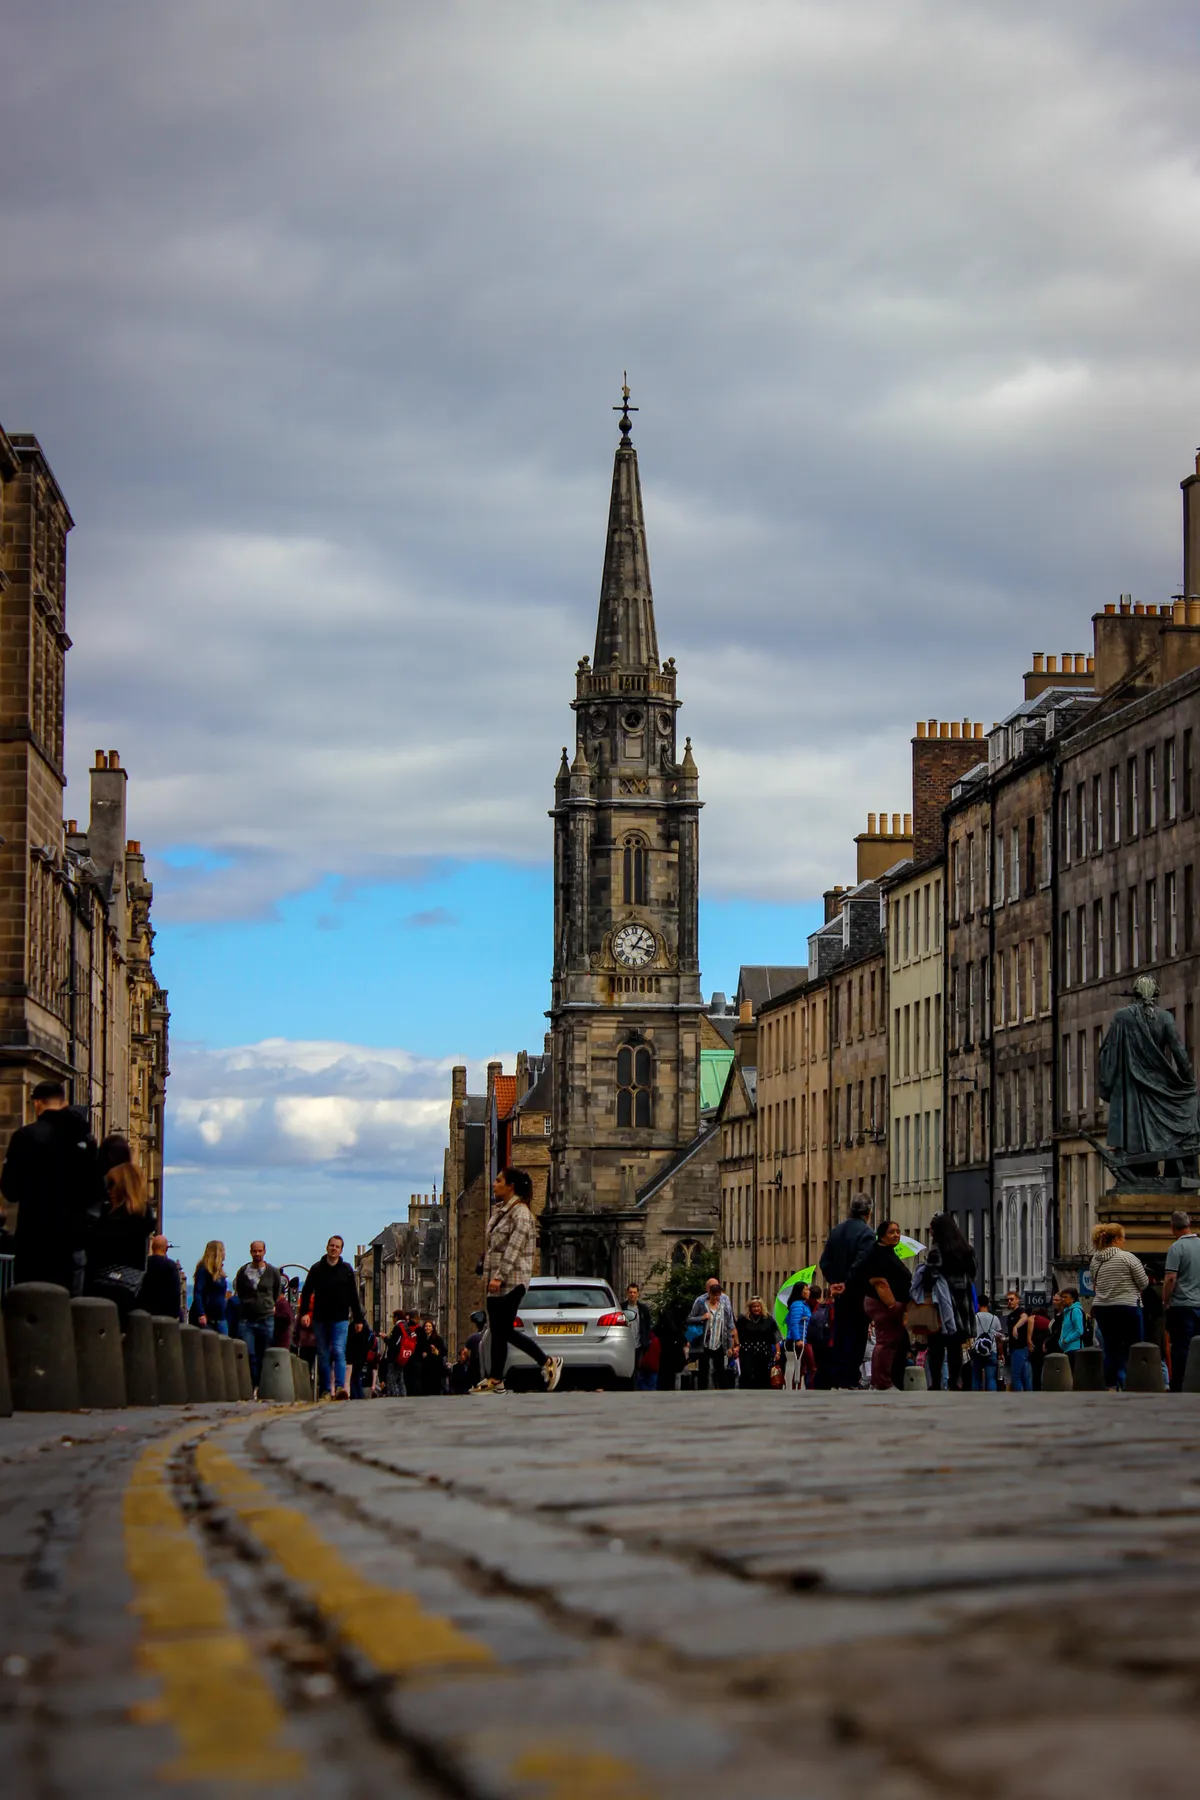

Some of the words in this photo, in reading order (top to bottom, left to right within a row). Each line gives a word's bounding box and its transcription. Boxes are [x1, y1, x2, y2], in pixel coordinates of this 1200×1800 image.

[1028, 1296, 1044, 1305] 166
[542, 1325, 561, 1333] SF17
[563, 1325, 579, 1333] JXU
